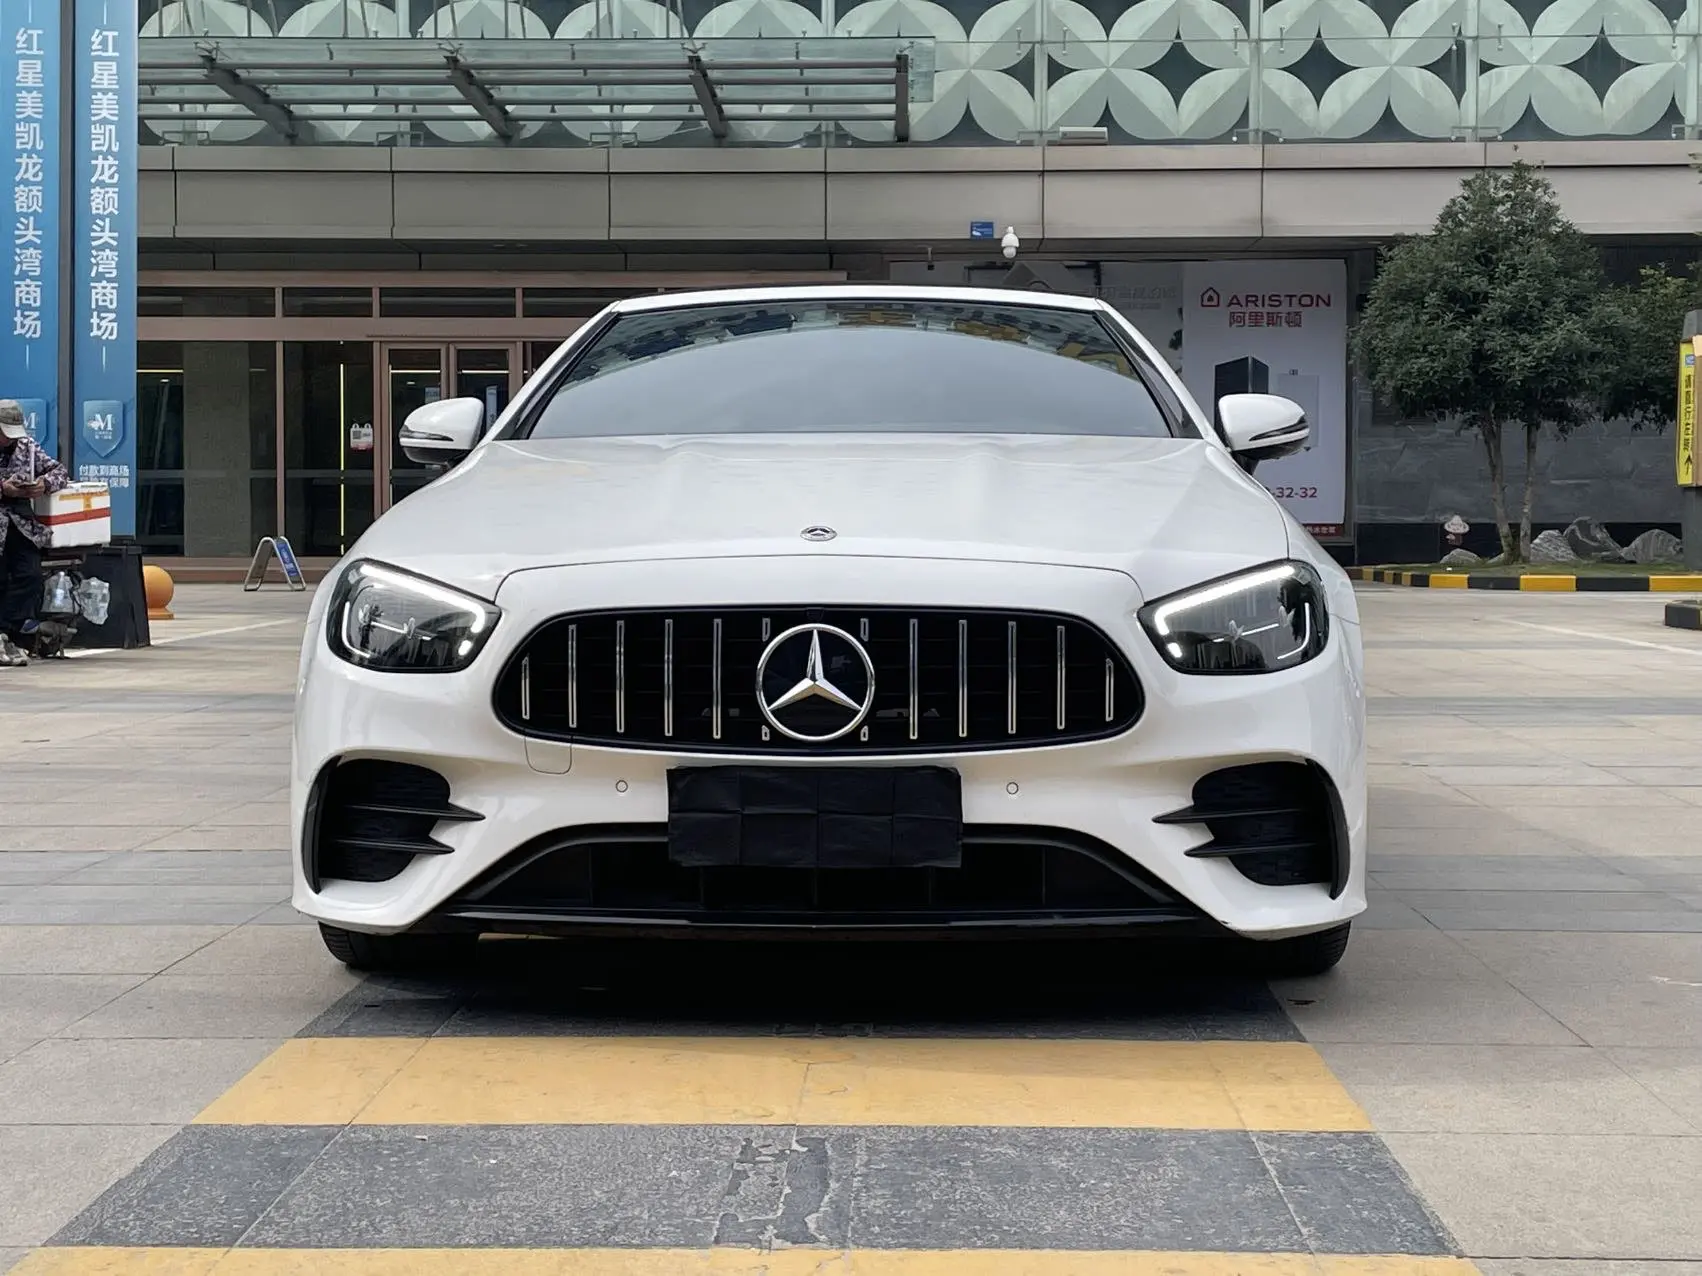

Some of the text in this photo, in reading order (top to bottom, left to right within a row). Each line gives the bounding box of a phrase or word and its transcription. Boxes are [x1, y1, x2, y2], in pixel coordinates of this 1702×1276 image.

[13, 27, 44, 339] 红星美凯龙额头湾商场
[90, 29, 119, 341] 红星美凯龙额头湾商场
[1227, 293, 1331, 307] ARISTON
[1229, 311, 1302, 328] 阿里斯顿
[1265, 487, 1317, 498] -32-32
